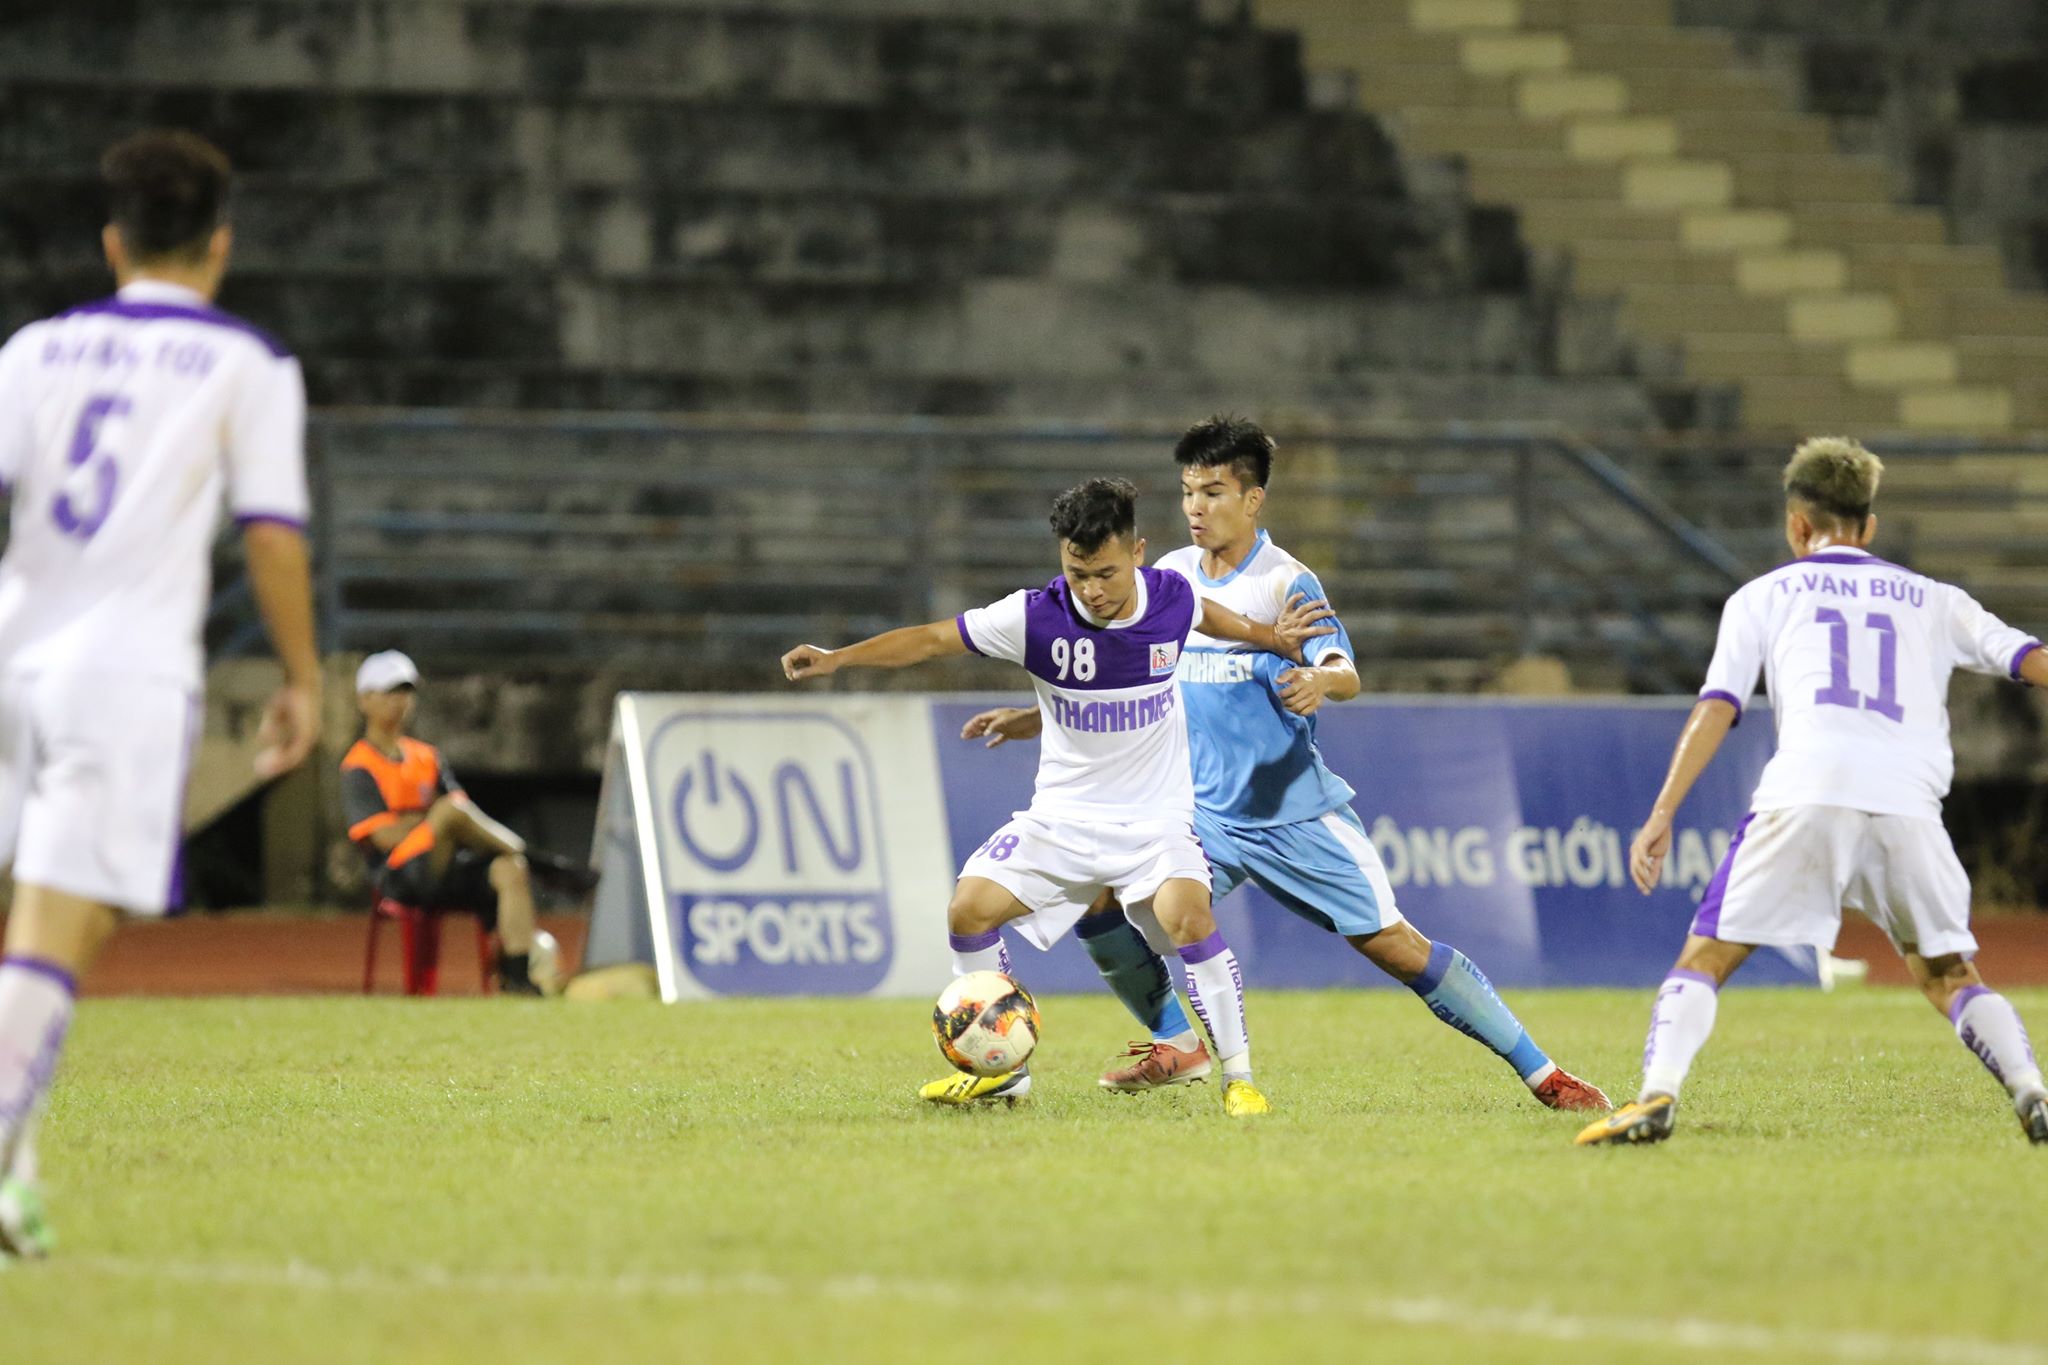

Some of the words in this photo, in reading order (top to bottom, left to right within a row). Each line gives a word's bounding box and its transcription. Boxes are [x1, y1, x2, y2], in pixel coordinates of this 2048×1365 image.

[49, 395, 131, 539] 5
[1051, 637, 1096, 682] 98
[1814, 606, 1905, 724] 11
[672, 750, 863, 875] ON
[1368, 814, 1498, 888] ÔNG
[688, 902, 885, 963] SPORTS
